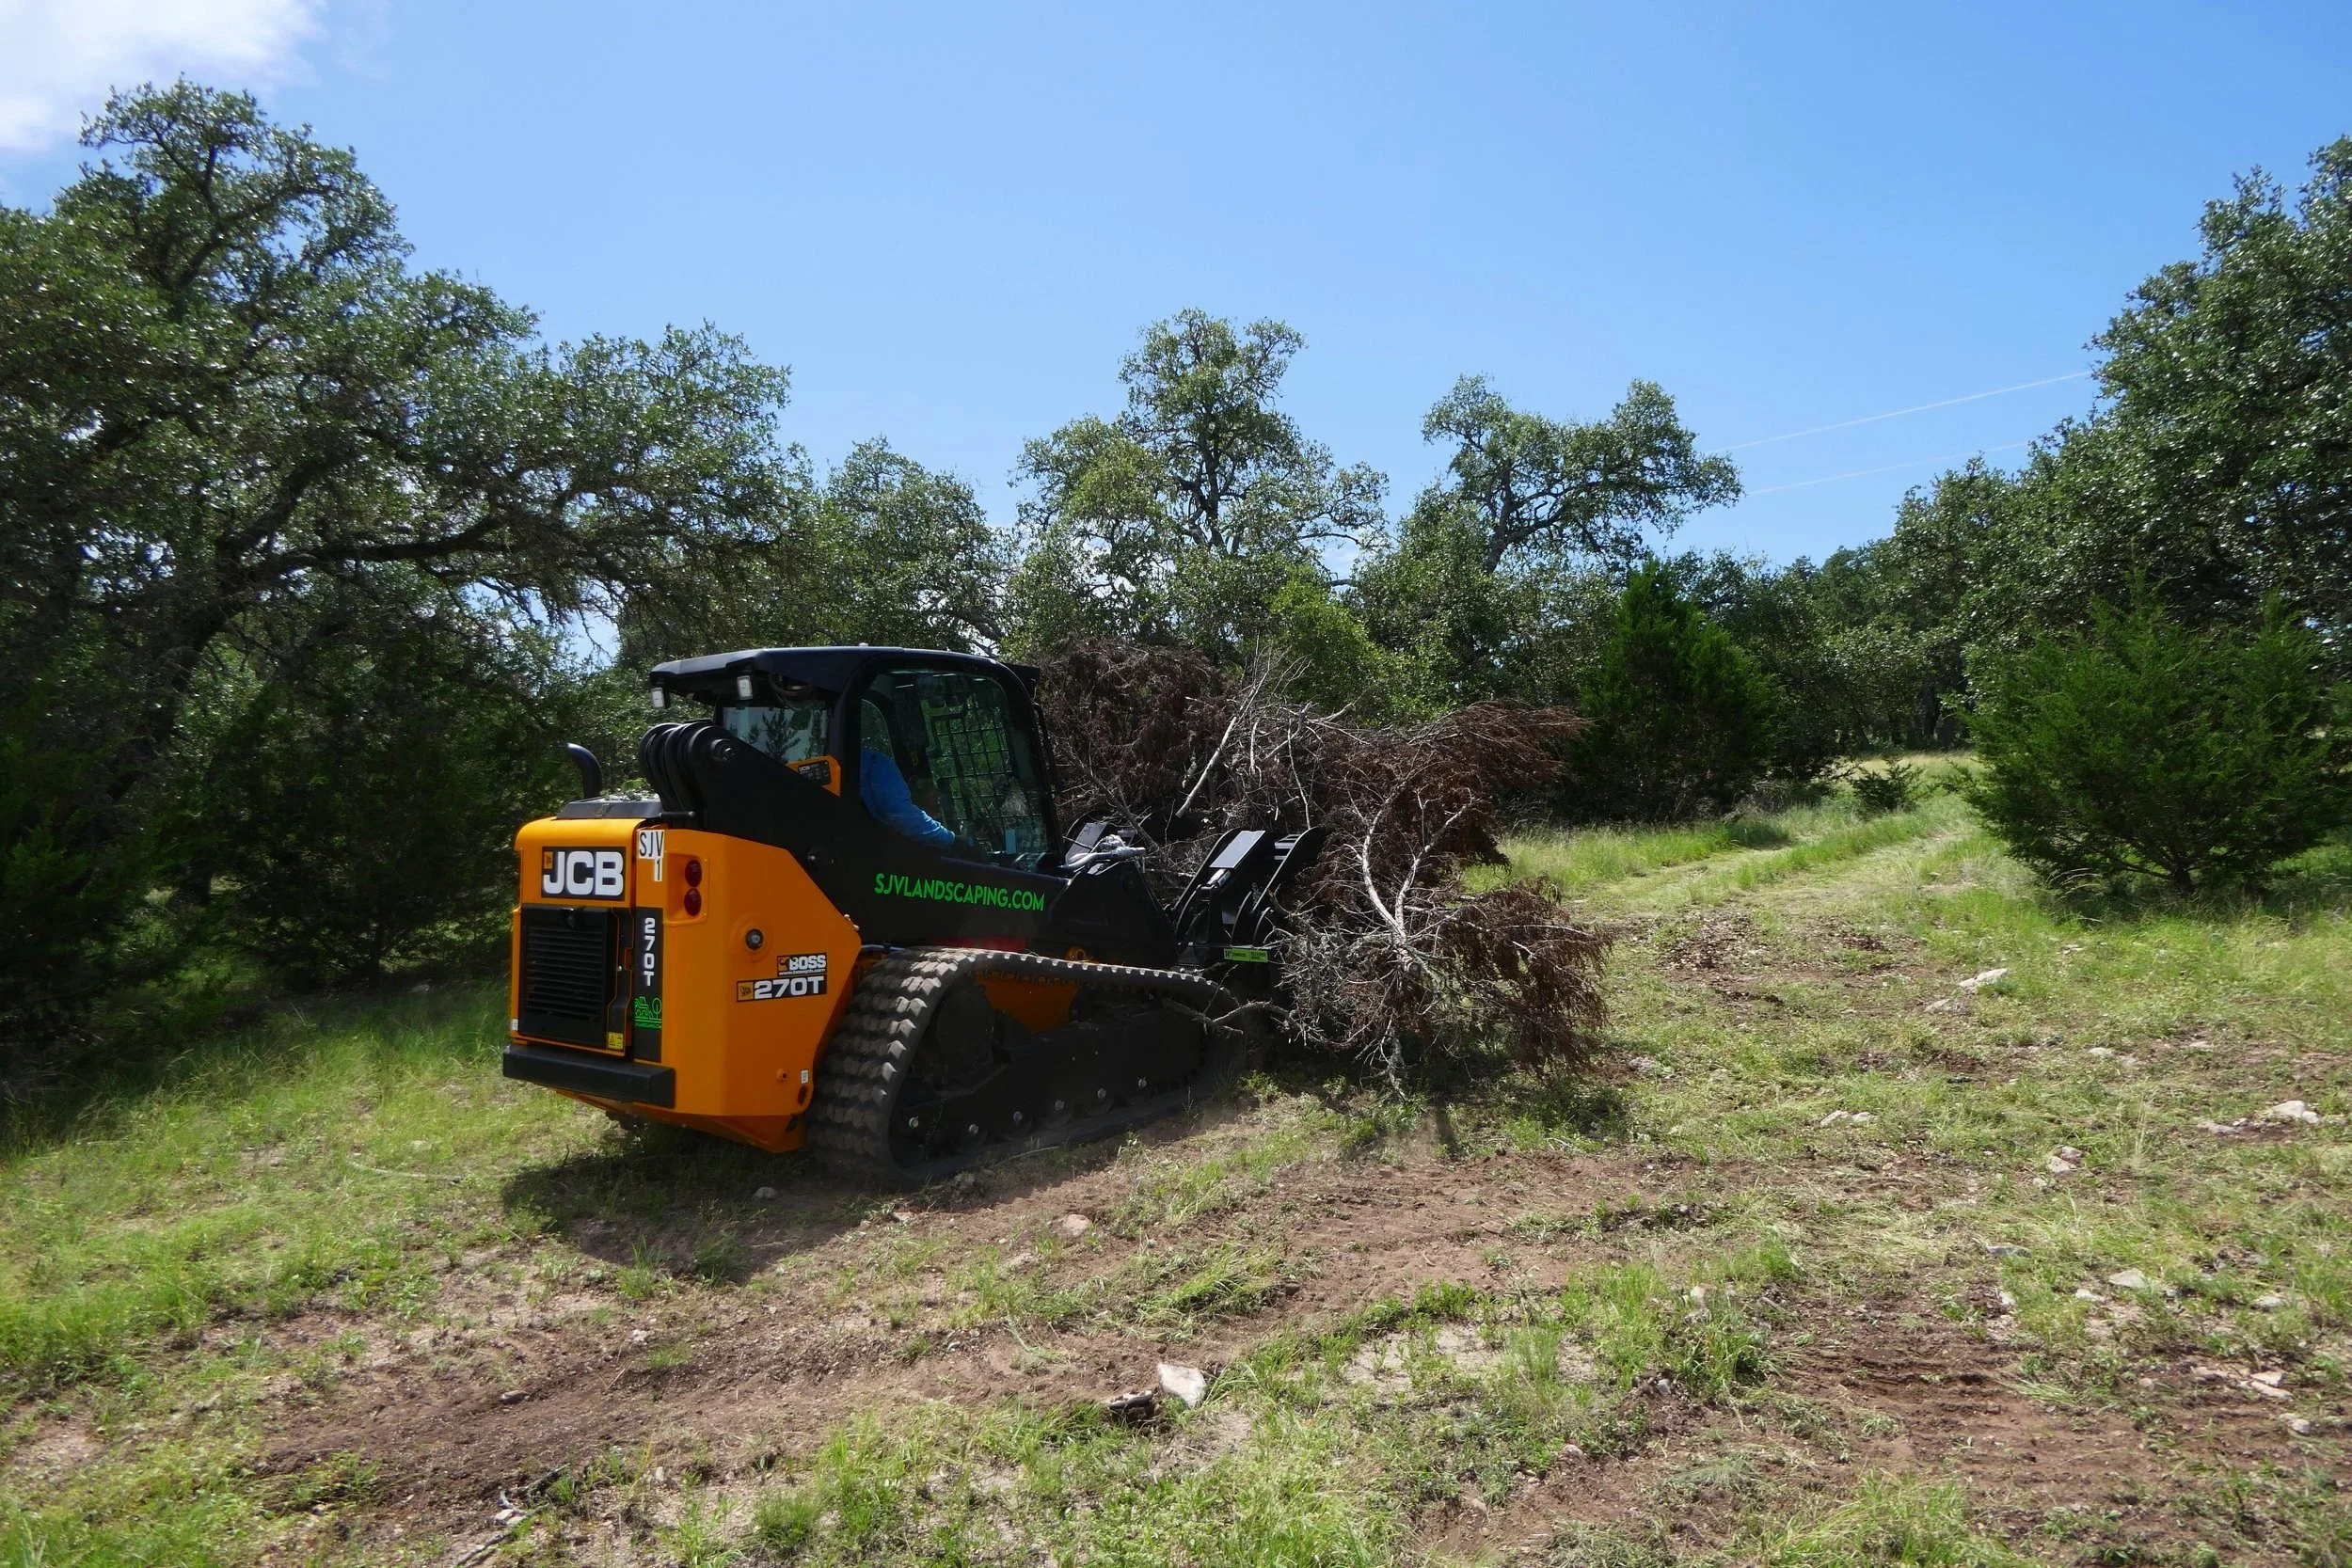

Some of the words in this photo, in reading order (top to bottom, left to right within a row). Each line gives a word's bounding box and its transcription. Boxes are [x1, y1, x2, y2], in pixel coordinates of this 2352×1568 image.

[640, 832, 663, 857] SJV
[543, 850, 624, 896] JCB
[656, 858, 661, 880] 1
[874, 873, 1045, 911] SJVLANDSCAPING.COM
[644, 917, 656, 987] 270T
[788, 954, 827, 971] BOSS
[754, 975, 825, 1000] 270T
